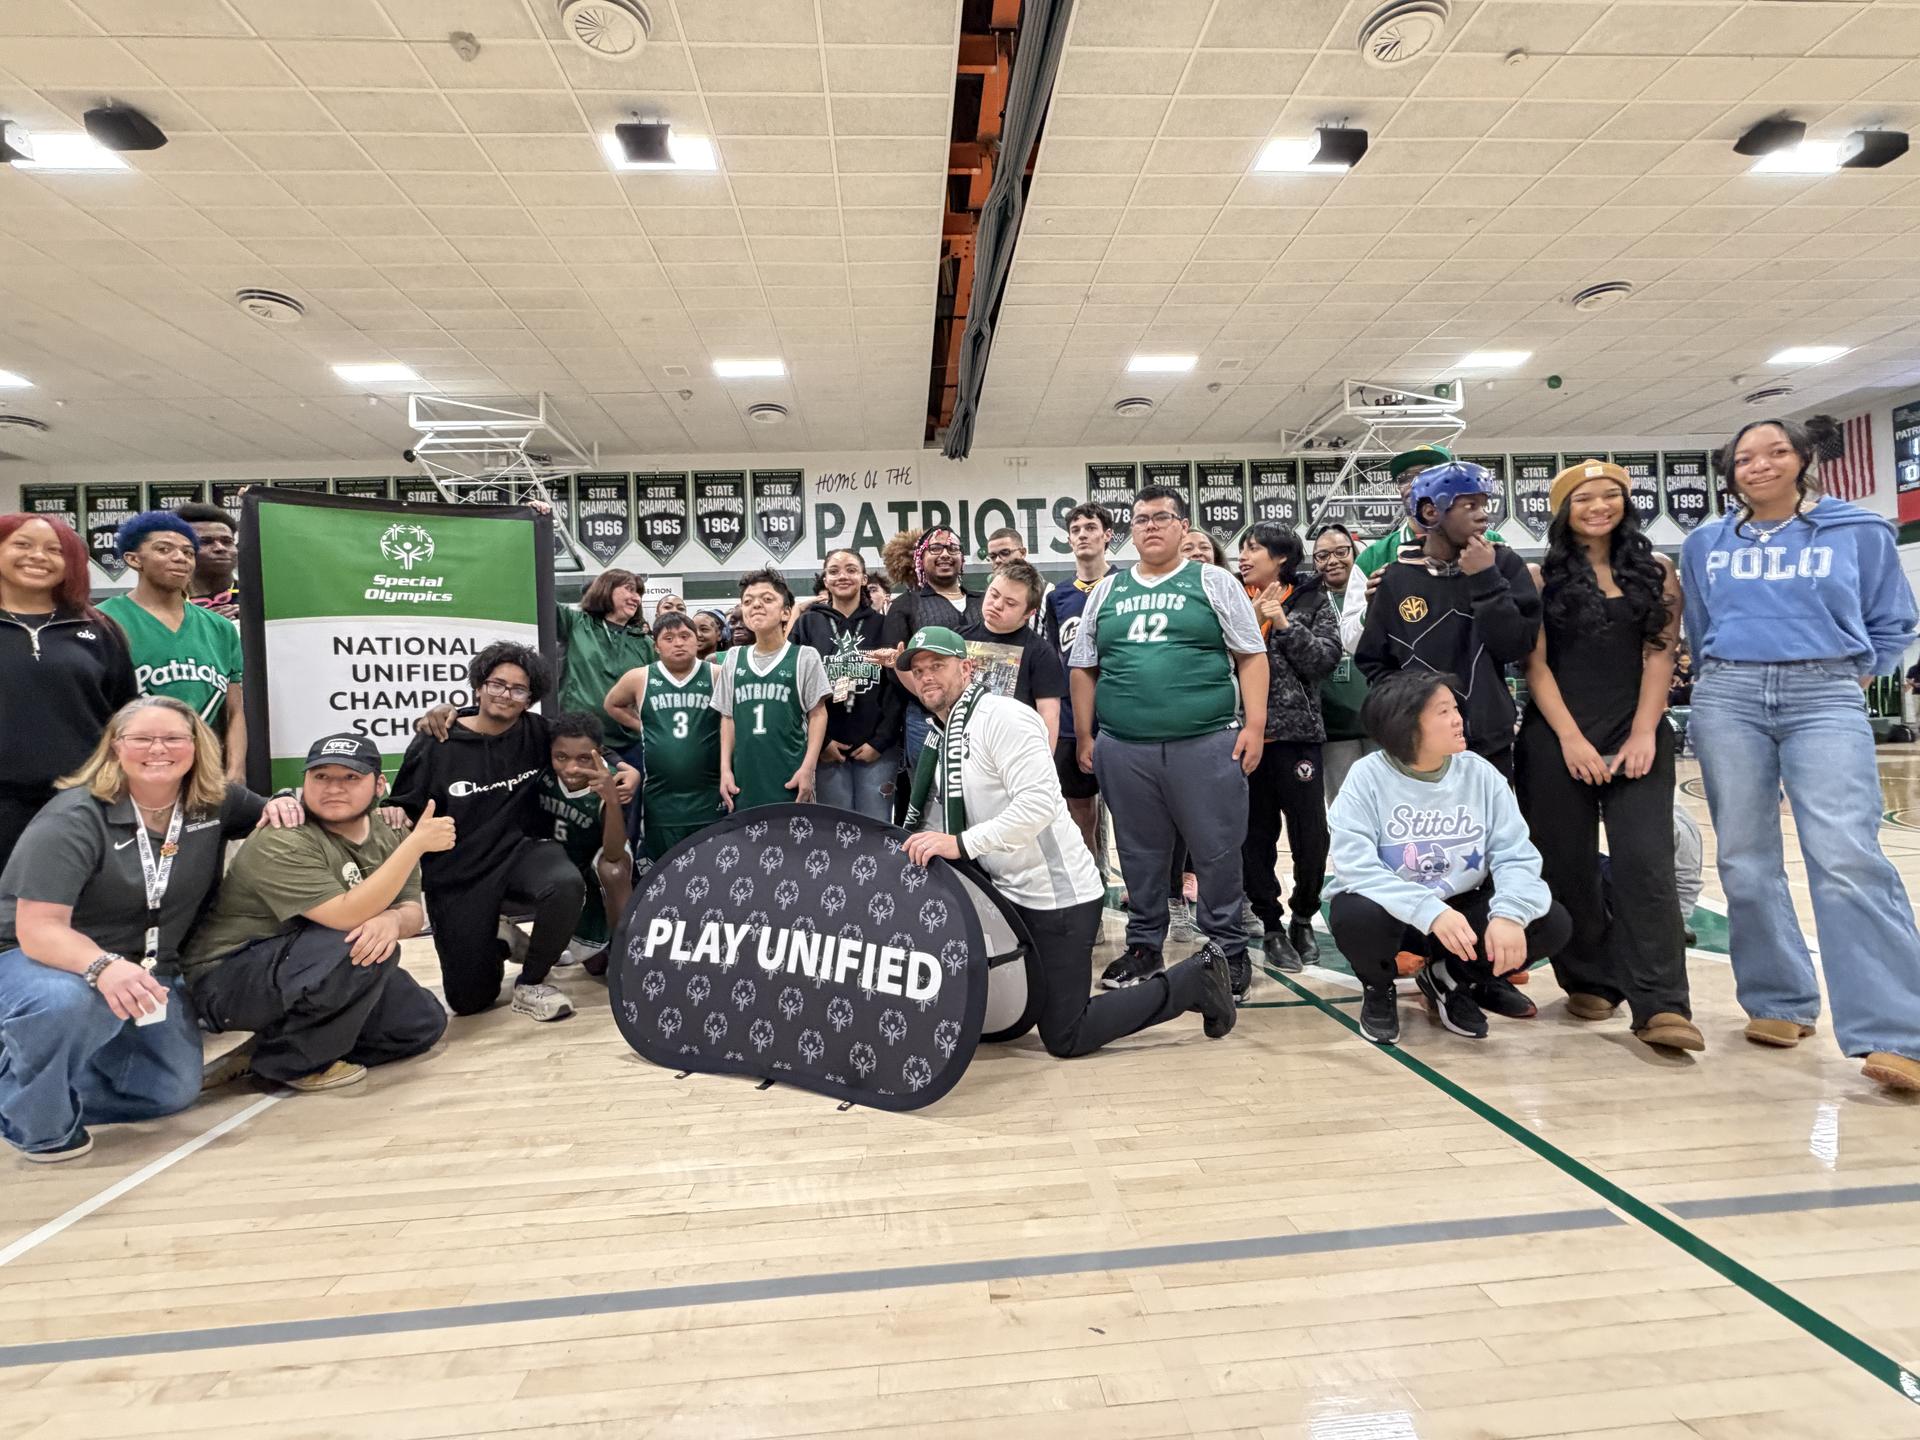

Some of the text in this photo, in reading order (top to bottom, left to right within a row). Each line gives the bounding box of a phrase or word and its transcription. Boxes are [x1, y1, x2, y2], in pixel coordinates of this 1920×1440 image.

[1523, 466, 1548, 477] STATE
[1673, 463, 1698, 474] STATE
[816, 470, 858, 494] HOME
[885, 466, 912, 486] THE
[1099, 477, 1126, 488] STATE
[1153, 475, 1180, 486] STATE
[1207, 474, 1234, 485] STATE
[1261, 472, 1287, 483] STATE
[1666, 475, 1707, 492] CHAMPIONS
[407, 491, 438, 502] STATE
[588, 487, 618, 499] STATE
[647, 486, 676, 498] STATE
[705, 485, 734, 496] STATE
[763, 484, 792, 495] STATE
[1091, 489, 1135, 505] CHAMPIONS
[1200, 486, 1243, 504] CHAMPIONS
[1253, 484, 1296, 502] CHAMPIONS
[35, 499, 66, 511] STATE
[97, 498, 129, 510] STATE
[580, 500, 627, 518] CHAMPIONS
[639, 499, 685, 517] CHAMPIONS
[697, 497, 744, 515] CHAMPIONS
[755, 496, 801, 514] CHAMPIONS
[1521, 498, 1551, 512] 1961
[1672, 493, 1704, 509] 1993
[1205, 505, 1239, 521] 1995
[1260, 503, 1292, 519] 1996
[586, 520, 623, 536] 1966
[645, 519, 681, 535] 1965
[703, 517, 740, 533] 1964
[761, 515, 795, 532] 1961
[815, 497, 1080, 562] PATRIOTS
[1212, 525, 1232, 540] GW
[593, 541, 616, 556] GW
[651, 540, 675, 555] GW
[710, 538, 733, 553] GW
[768, 536, 791, 552] GW
[1706, 545, 1833, 582] POLO
[372, 574, 444, 588] Special
[364, 588, 453, 603] Olympics
[1115, 592, 1187, 617] PATRIOTS
[77, 629, 97, 641] alo
[1126, 611, 1169, 644] 42
[333, 636, 481, 656] NATIONAL
[134, 657, 231, 694] Patriots
[352, 663, 468, 682] UNIFIED
[735, 682, 792, 705] PATRIOTS
[650, 692, 711, 712] PATRIOTS
[672, 710, 689, 739] 3
[752, 703, 768, 735] 1
[448, 768, 540, 798] Champion
[554, 818, 569, 842] 5
[1385, 804, 1485, 841] Stitch
[643, 918, 943, 1001] PLAY UNIFIED
